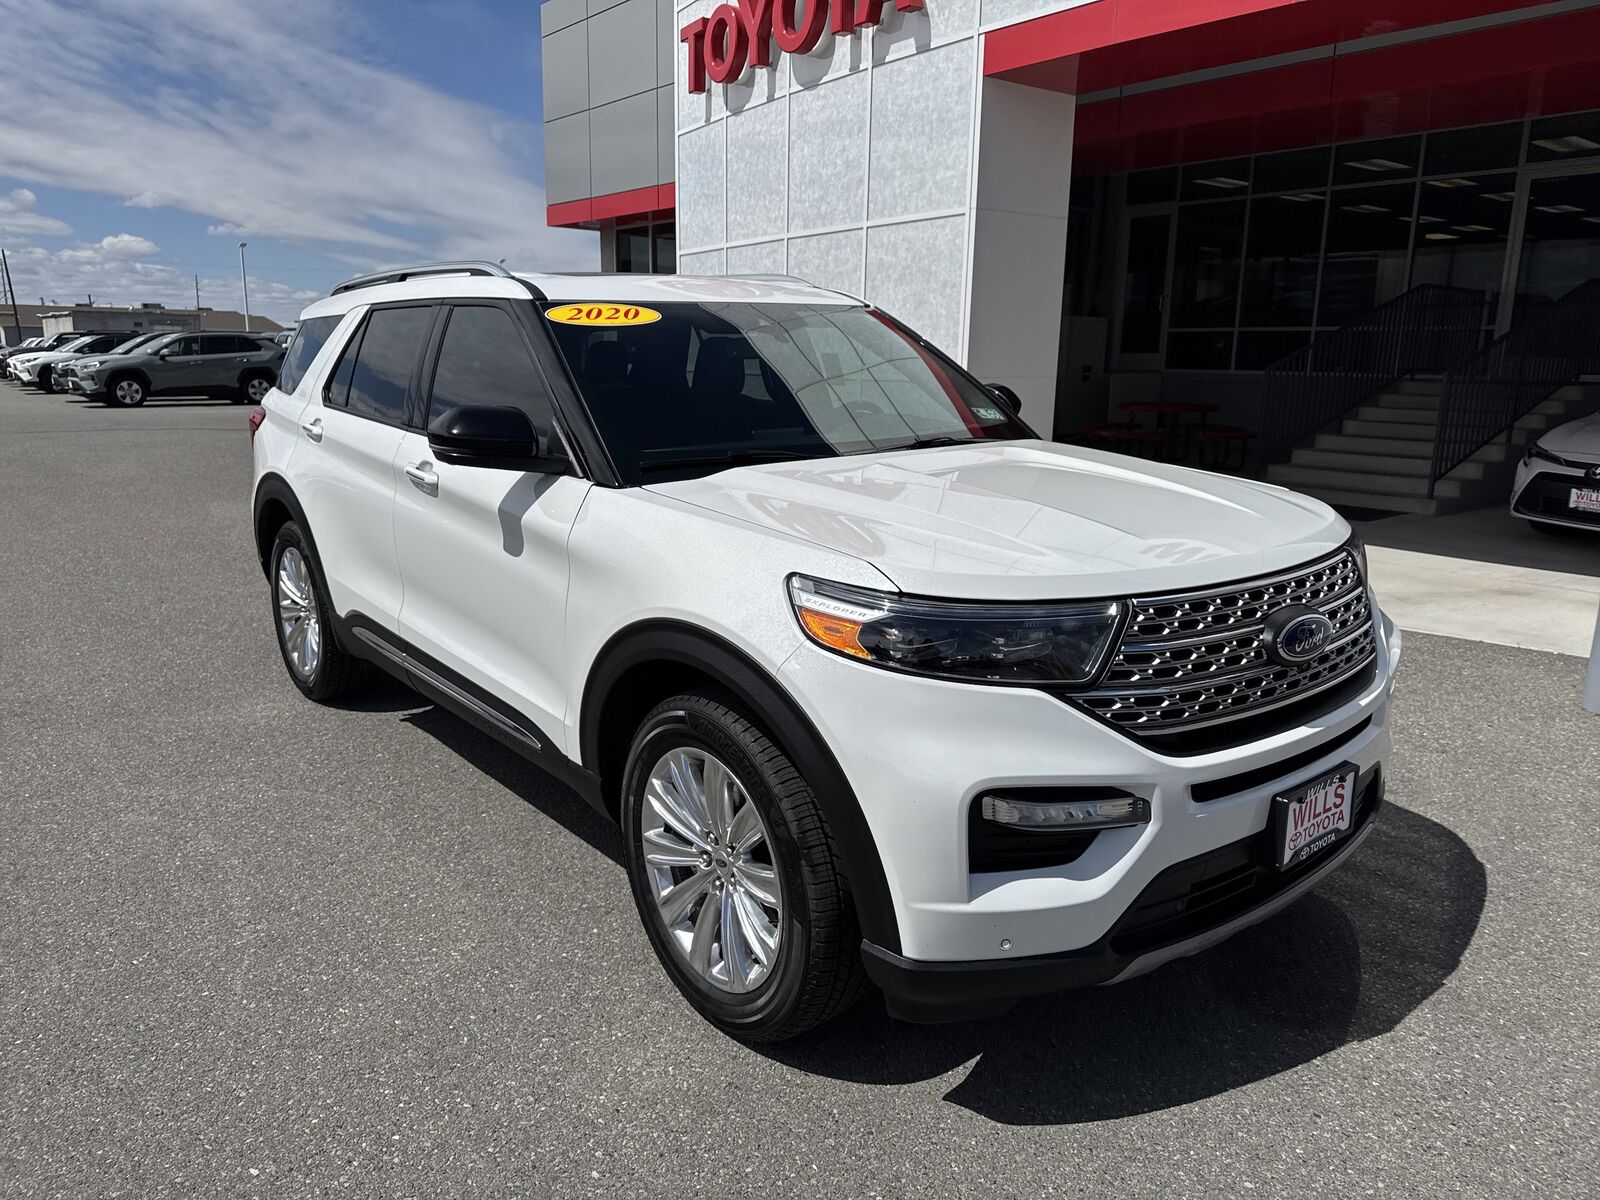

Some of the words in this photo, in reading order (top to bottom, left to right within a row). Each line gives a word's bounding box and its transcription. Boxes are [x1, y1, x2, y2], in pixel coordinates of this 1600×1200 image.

[680, 0, 925, 94] TOYO
[567, 307, 640, 320] 2020
[805, 597, 867, 618] EXPLORER
[1296, 623, 1324, 652] Ford
[1293, 783, 1345, 831] WILLS
[1303, 809, 1345, 842] TOYOTA
[1310, 832, 1336, 853] TOYOTA
